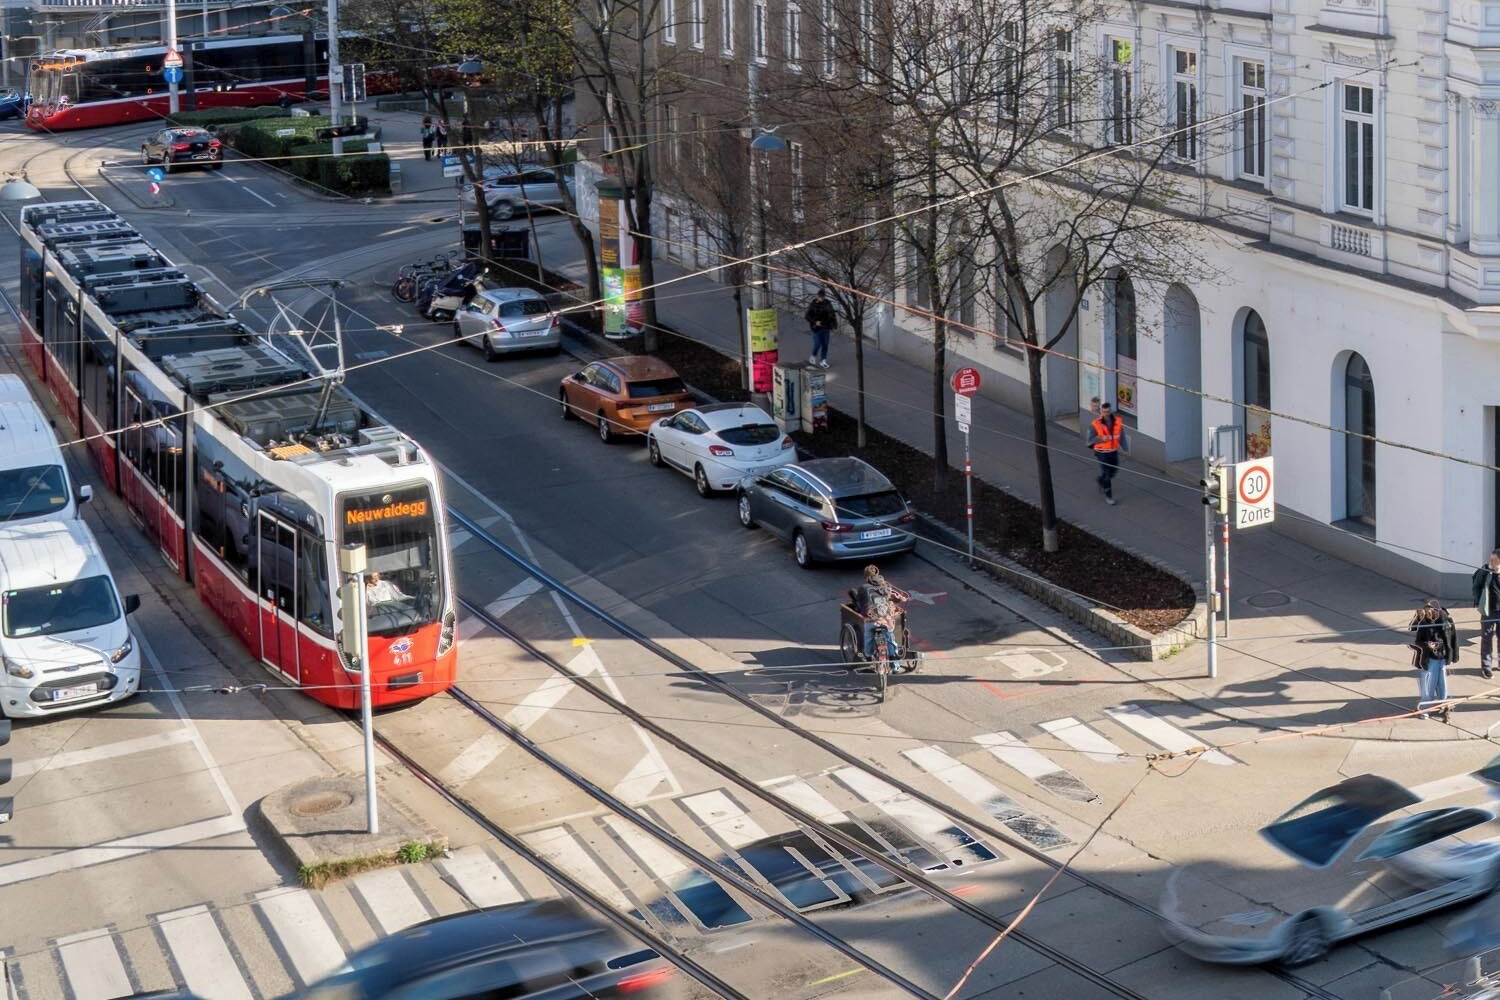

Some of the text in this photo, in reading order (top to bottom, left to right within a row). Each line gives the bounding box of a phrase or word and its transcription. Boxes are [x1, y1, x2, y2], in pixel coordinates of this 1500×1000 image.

[1247, 475, 1263, 495] 30
[346, 500, 427, 525] Neuwaldegg
[1241, 507, 1271, 524] Zone
